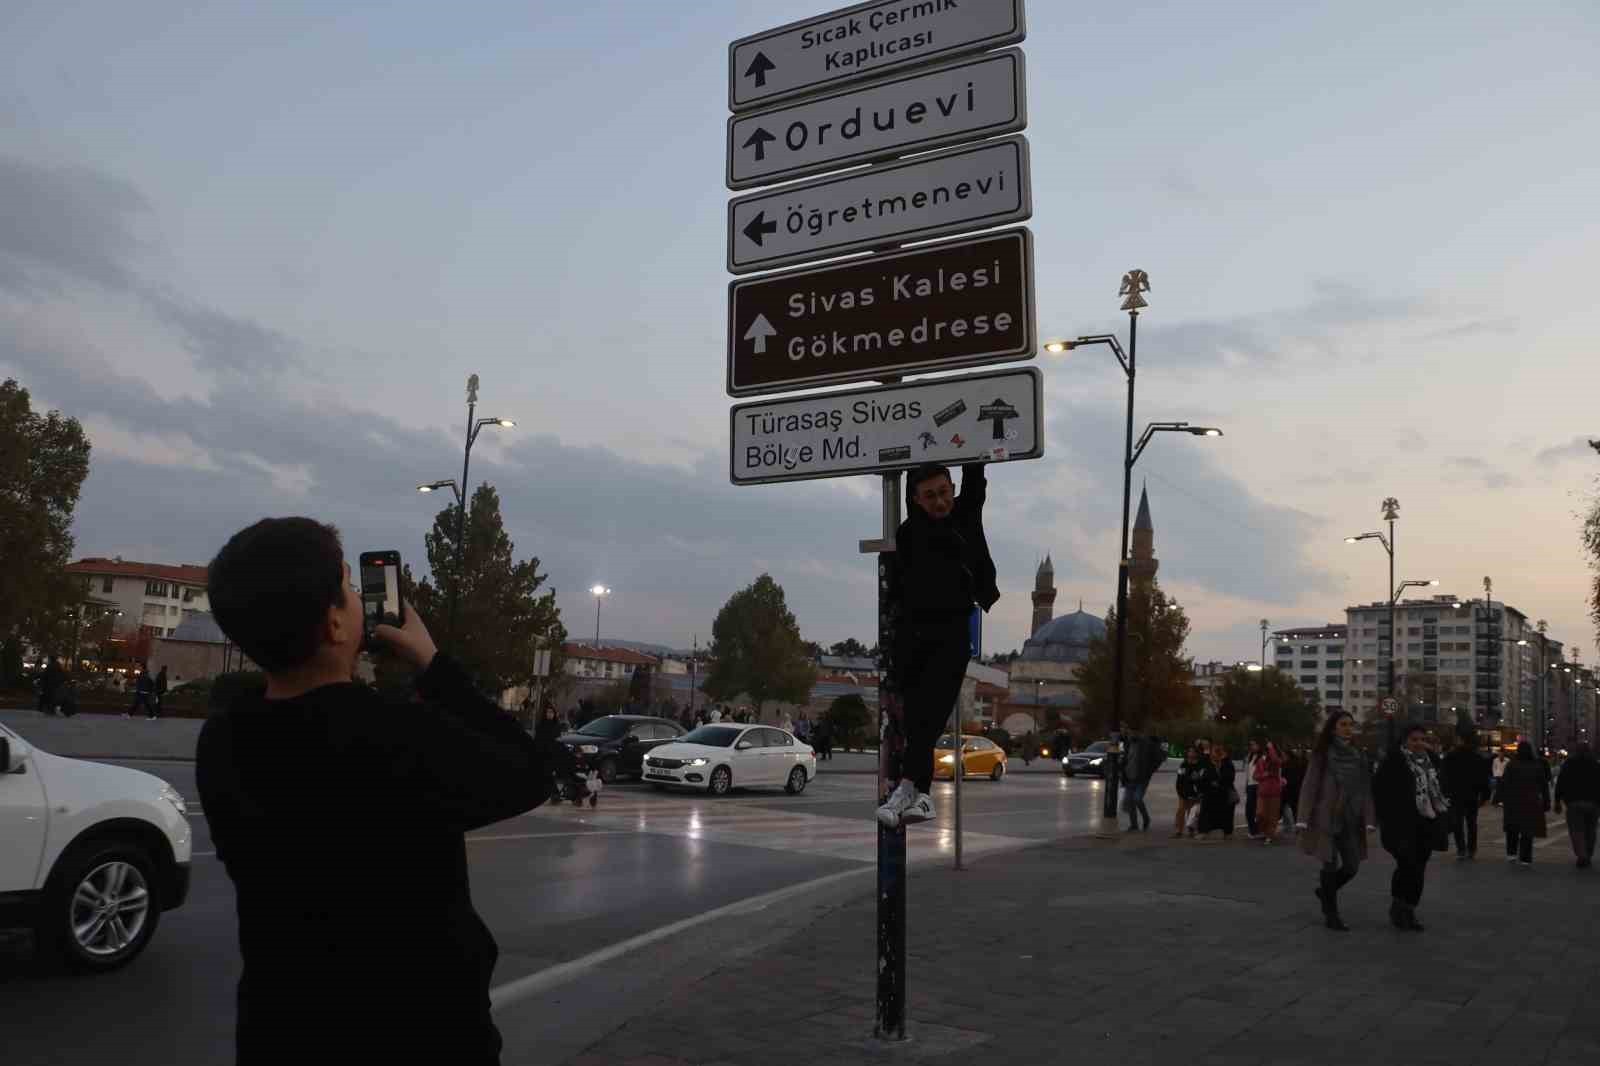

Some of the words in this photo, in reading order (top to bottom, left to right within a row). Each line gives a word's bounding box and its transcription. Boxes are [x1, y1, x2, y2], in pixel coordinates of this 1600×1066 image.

[801, 19, 861, 49] Sıcak
[825, 31, 933, 71] Kaplıcası
[785, 82, 974, 151] Orduevi
[787, 171, 1005, 236] Öğretmenevi
[787, 287, 875, 318] Sivas
[893, 259, 1001, 301] Kalesi
[787, 311, 1013, 361] Gökmedrese
[745, 409, 843, 435] Türasaş
[852, 400, 922, 424] Sivas
[823, 435, 867, 461] Md.
